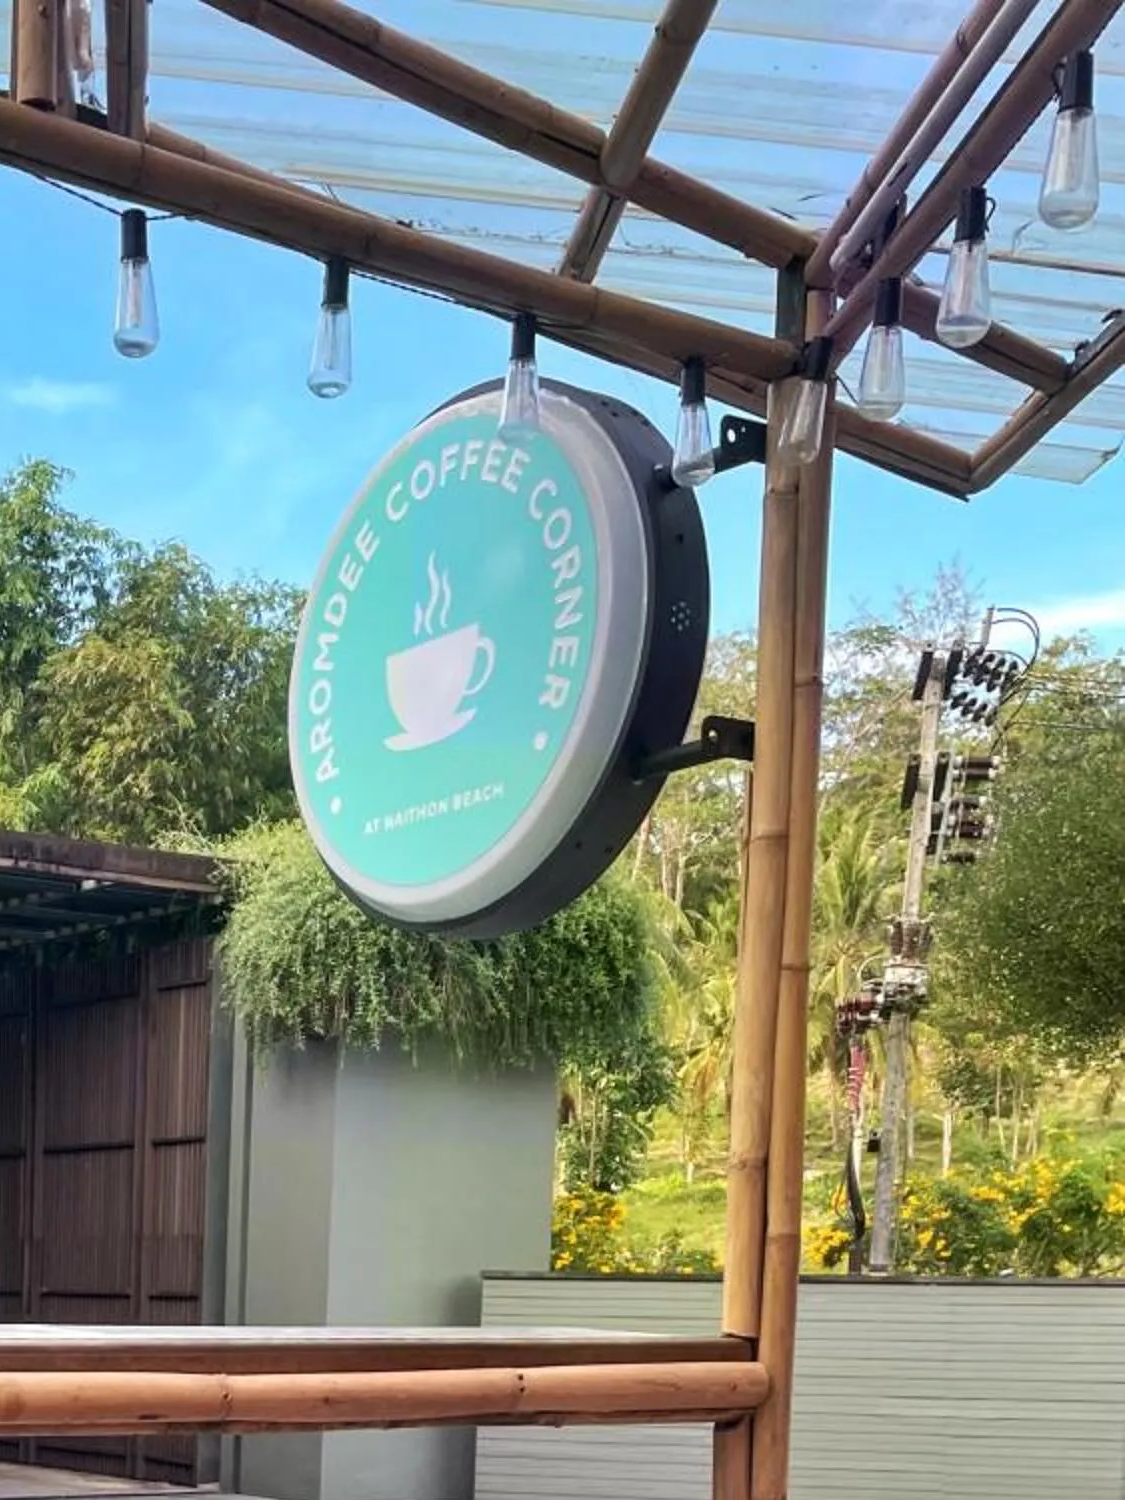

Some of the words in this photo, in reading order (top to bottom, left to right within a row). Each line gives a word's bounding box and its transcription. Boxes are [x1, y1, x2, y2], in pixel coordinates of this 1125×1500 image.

[309, 520, 380, 784] AROMDEE
[385, 439, 533, 521] COFFEE
[527, 478, 584, 709] CORNER
[363, 817, 381, 833] AT
[452, 782, 505, 812] BEACH
